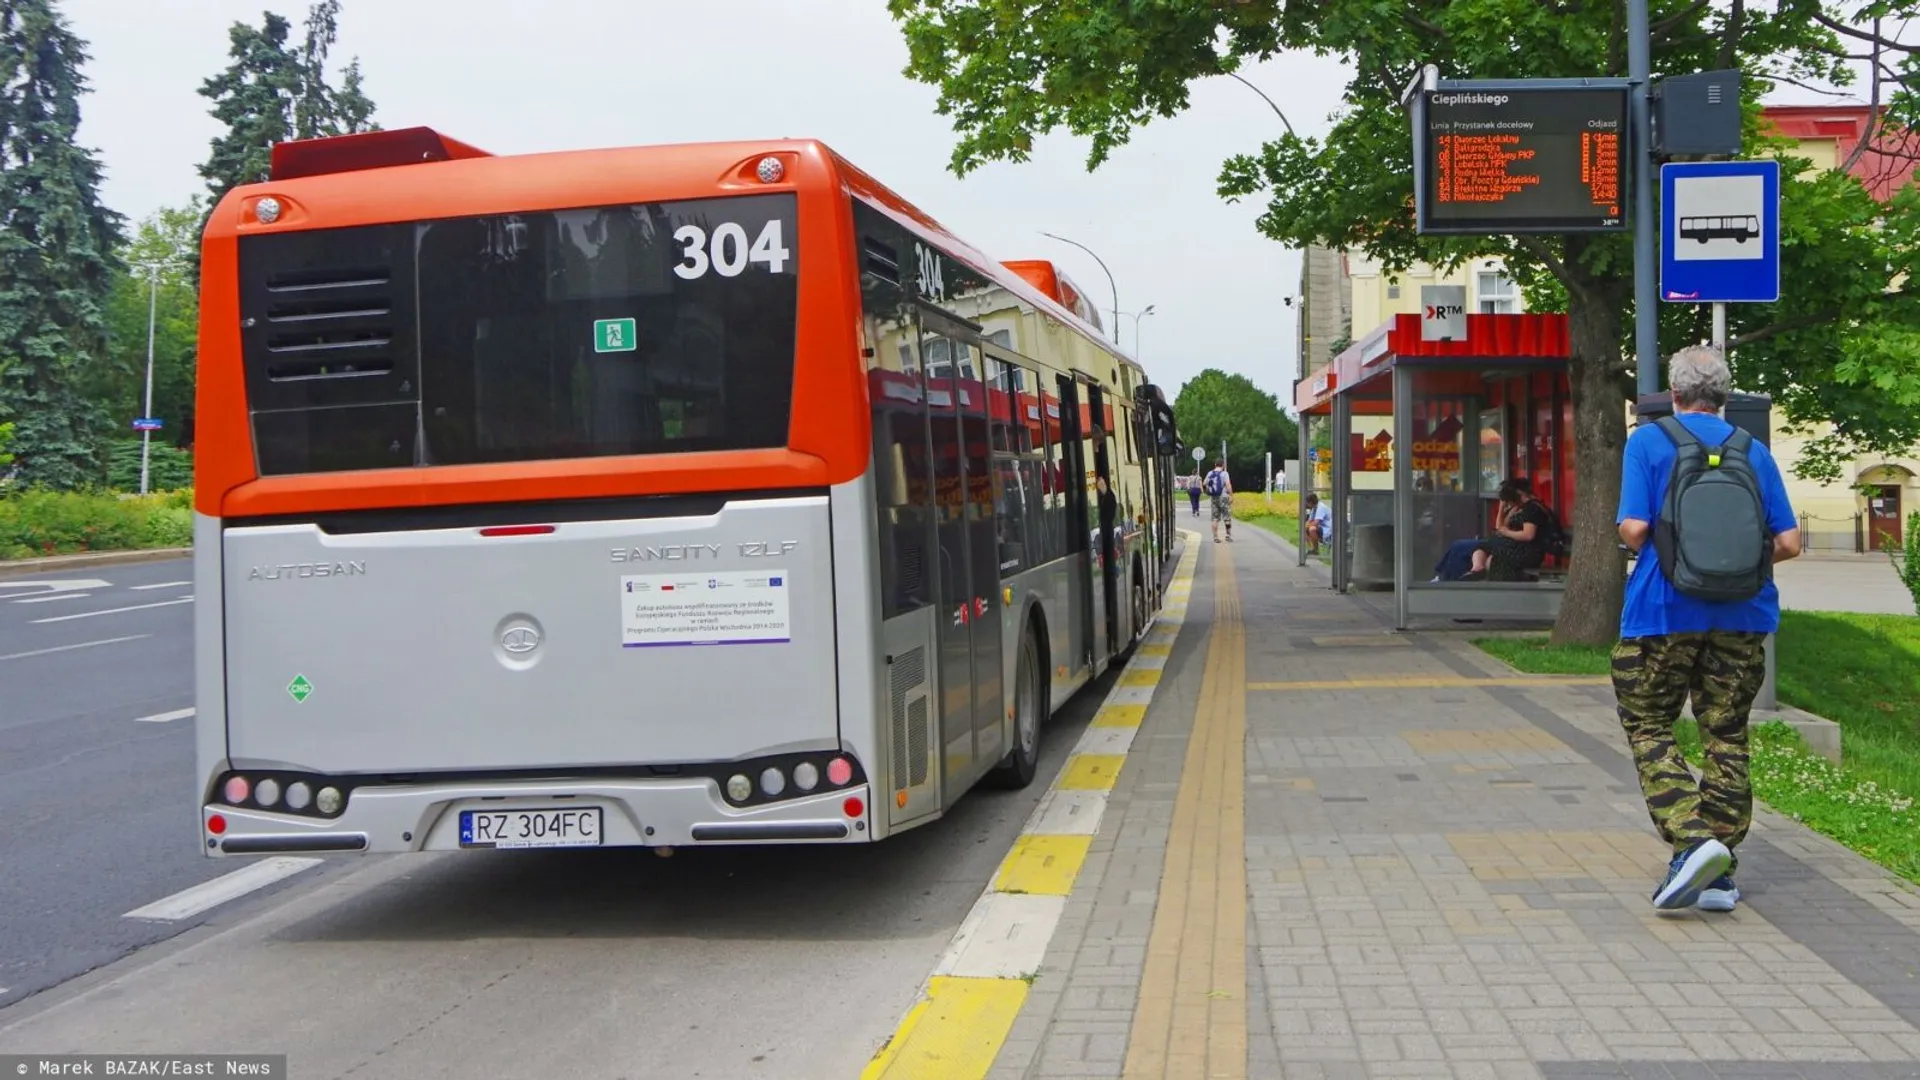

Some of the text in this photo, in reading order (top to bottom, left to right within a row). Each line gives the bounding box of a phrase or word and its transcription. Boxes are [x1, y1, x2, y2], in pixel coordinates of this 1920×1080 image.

[1431, 92, 1509, 106] Cieplińskiego
[1430, 119, 1617, 130] Linia Przystanek docelowy Odjazd
[1439, 135, 1451, 144] 14
[1488, 134, 1520, 144] Lokalny
[1518, 150, 1536, 159] PKP
[673, 219, 790, 280] 304
[915, 241, 945, 303] 304
[610, 544, 722, 563] SANCITY
[247, 560, 367, 581] AUTOSAN
[290, 683, 310, 694] CNG
[477, 811, 593, 839] RZ 304FC
